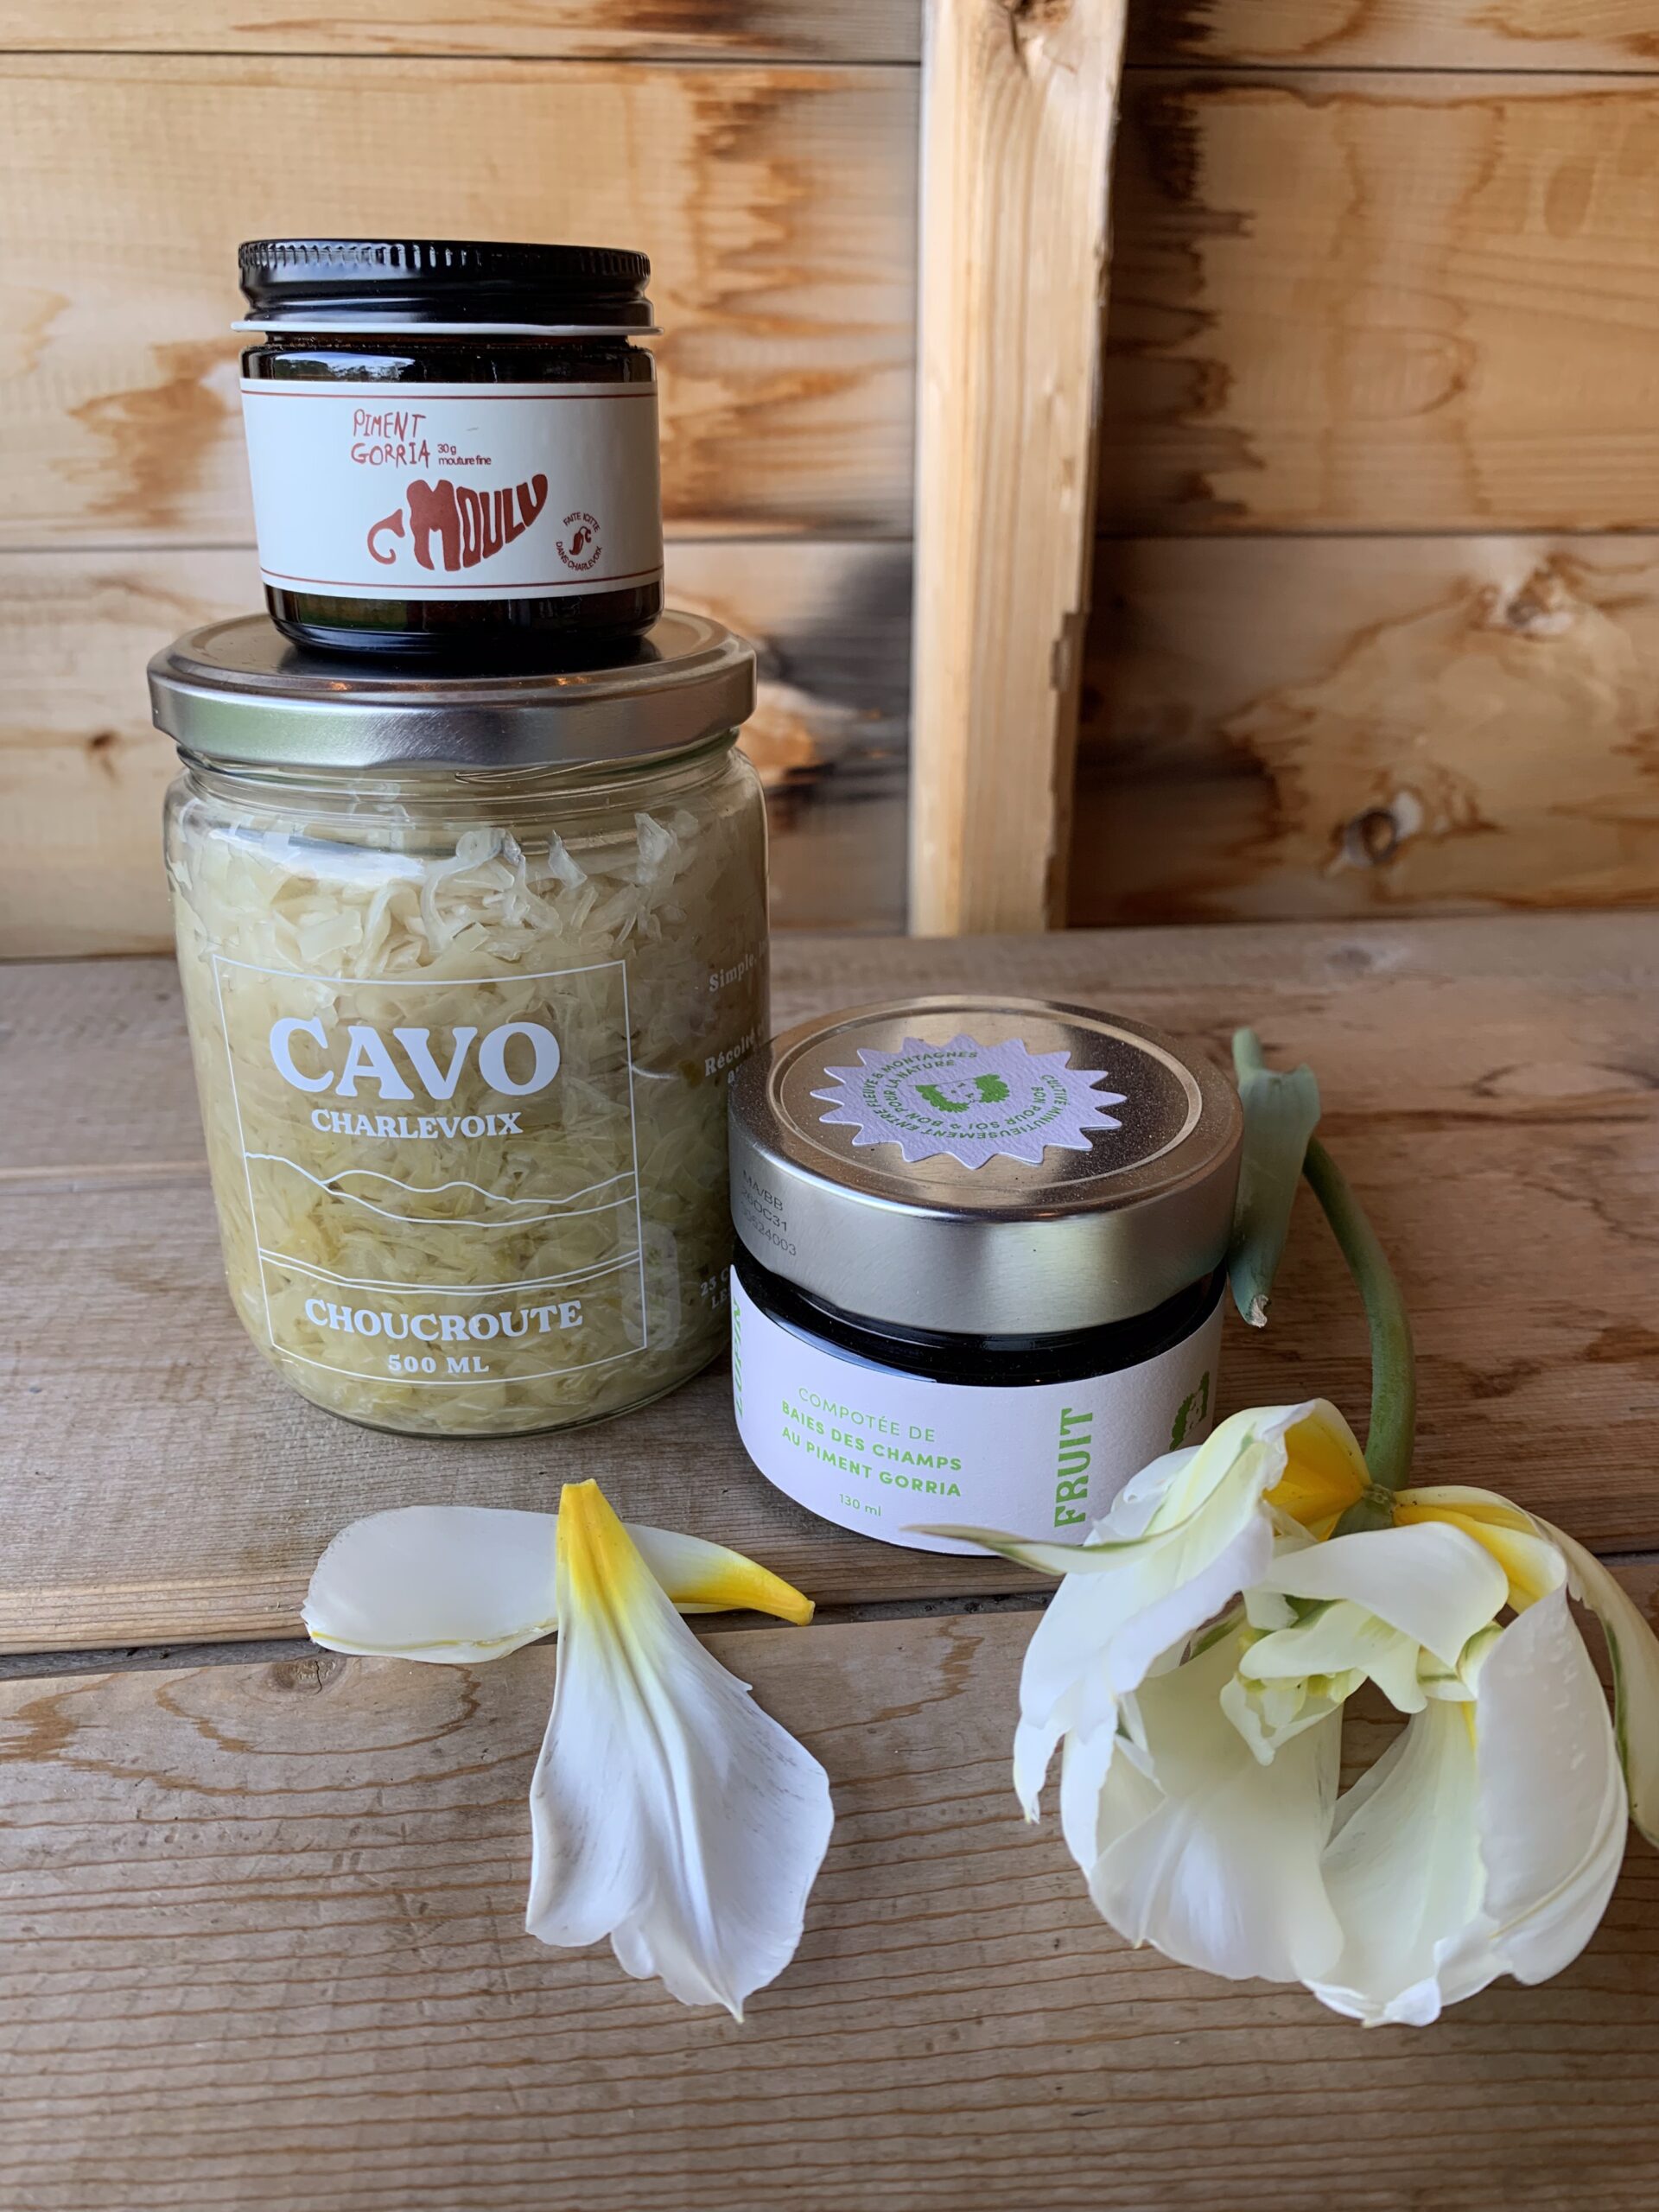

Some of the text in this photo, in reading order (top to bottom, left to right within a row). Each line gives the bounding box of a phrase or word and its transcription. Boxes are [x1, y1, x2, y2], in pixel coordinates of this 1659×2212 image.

[353, 409, 427, 442] PIMENT
[351, 439, 430, 468] GORRIA
[437, 443, 456, 455] 30 g
[438, 454, 492, 466] mouture fine
[406, 474, 548, 571] MOULU
[563, 512, 582, 527] FAITE
[556, 541, 602, 571] DANS CHARLEVOIX
[269, 1016, 561, 1100] CAVO
[881, 1052, 978, 1073] MONTAGNES
[896, 1060, 955, 1079] NATURE
[862, 1078, 881, 1108] FLEUVE
[885, 1078, 901, 1089] LA
[1031, 1086, 1046, 1104] BON
[883, 1090, 909, 1113] POUR
[310, 1108, 524, 1139] CHARLEVOIX
[873, 1109, 920, 1131] ENTRE
[905, 1112, 944, 1127] BON
[921, 1106, 1064, 1139] MINUTIEUSEMENT
[969, 1121, 1000, 1130] SOI
[1005, 1105, 1041, 1125] POUR
[305, 1298, 583, 1341] CHOUCROUTE
[389, 1354, 490, 1373] 500 ML
[798, 1388, 935, 1442] COMPOTÉE DE
[782, 1400, 962, 1471] BAIES DES CHAMPS
[782, 1427, 961, 1497] AU PIMENT GORRIA
[1054, 1408, 1093, 1528] FRUIT
[839, 1493, 881, 1516] 130 ml
